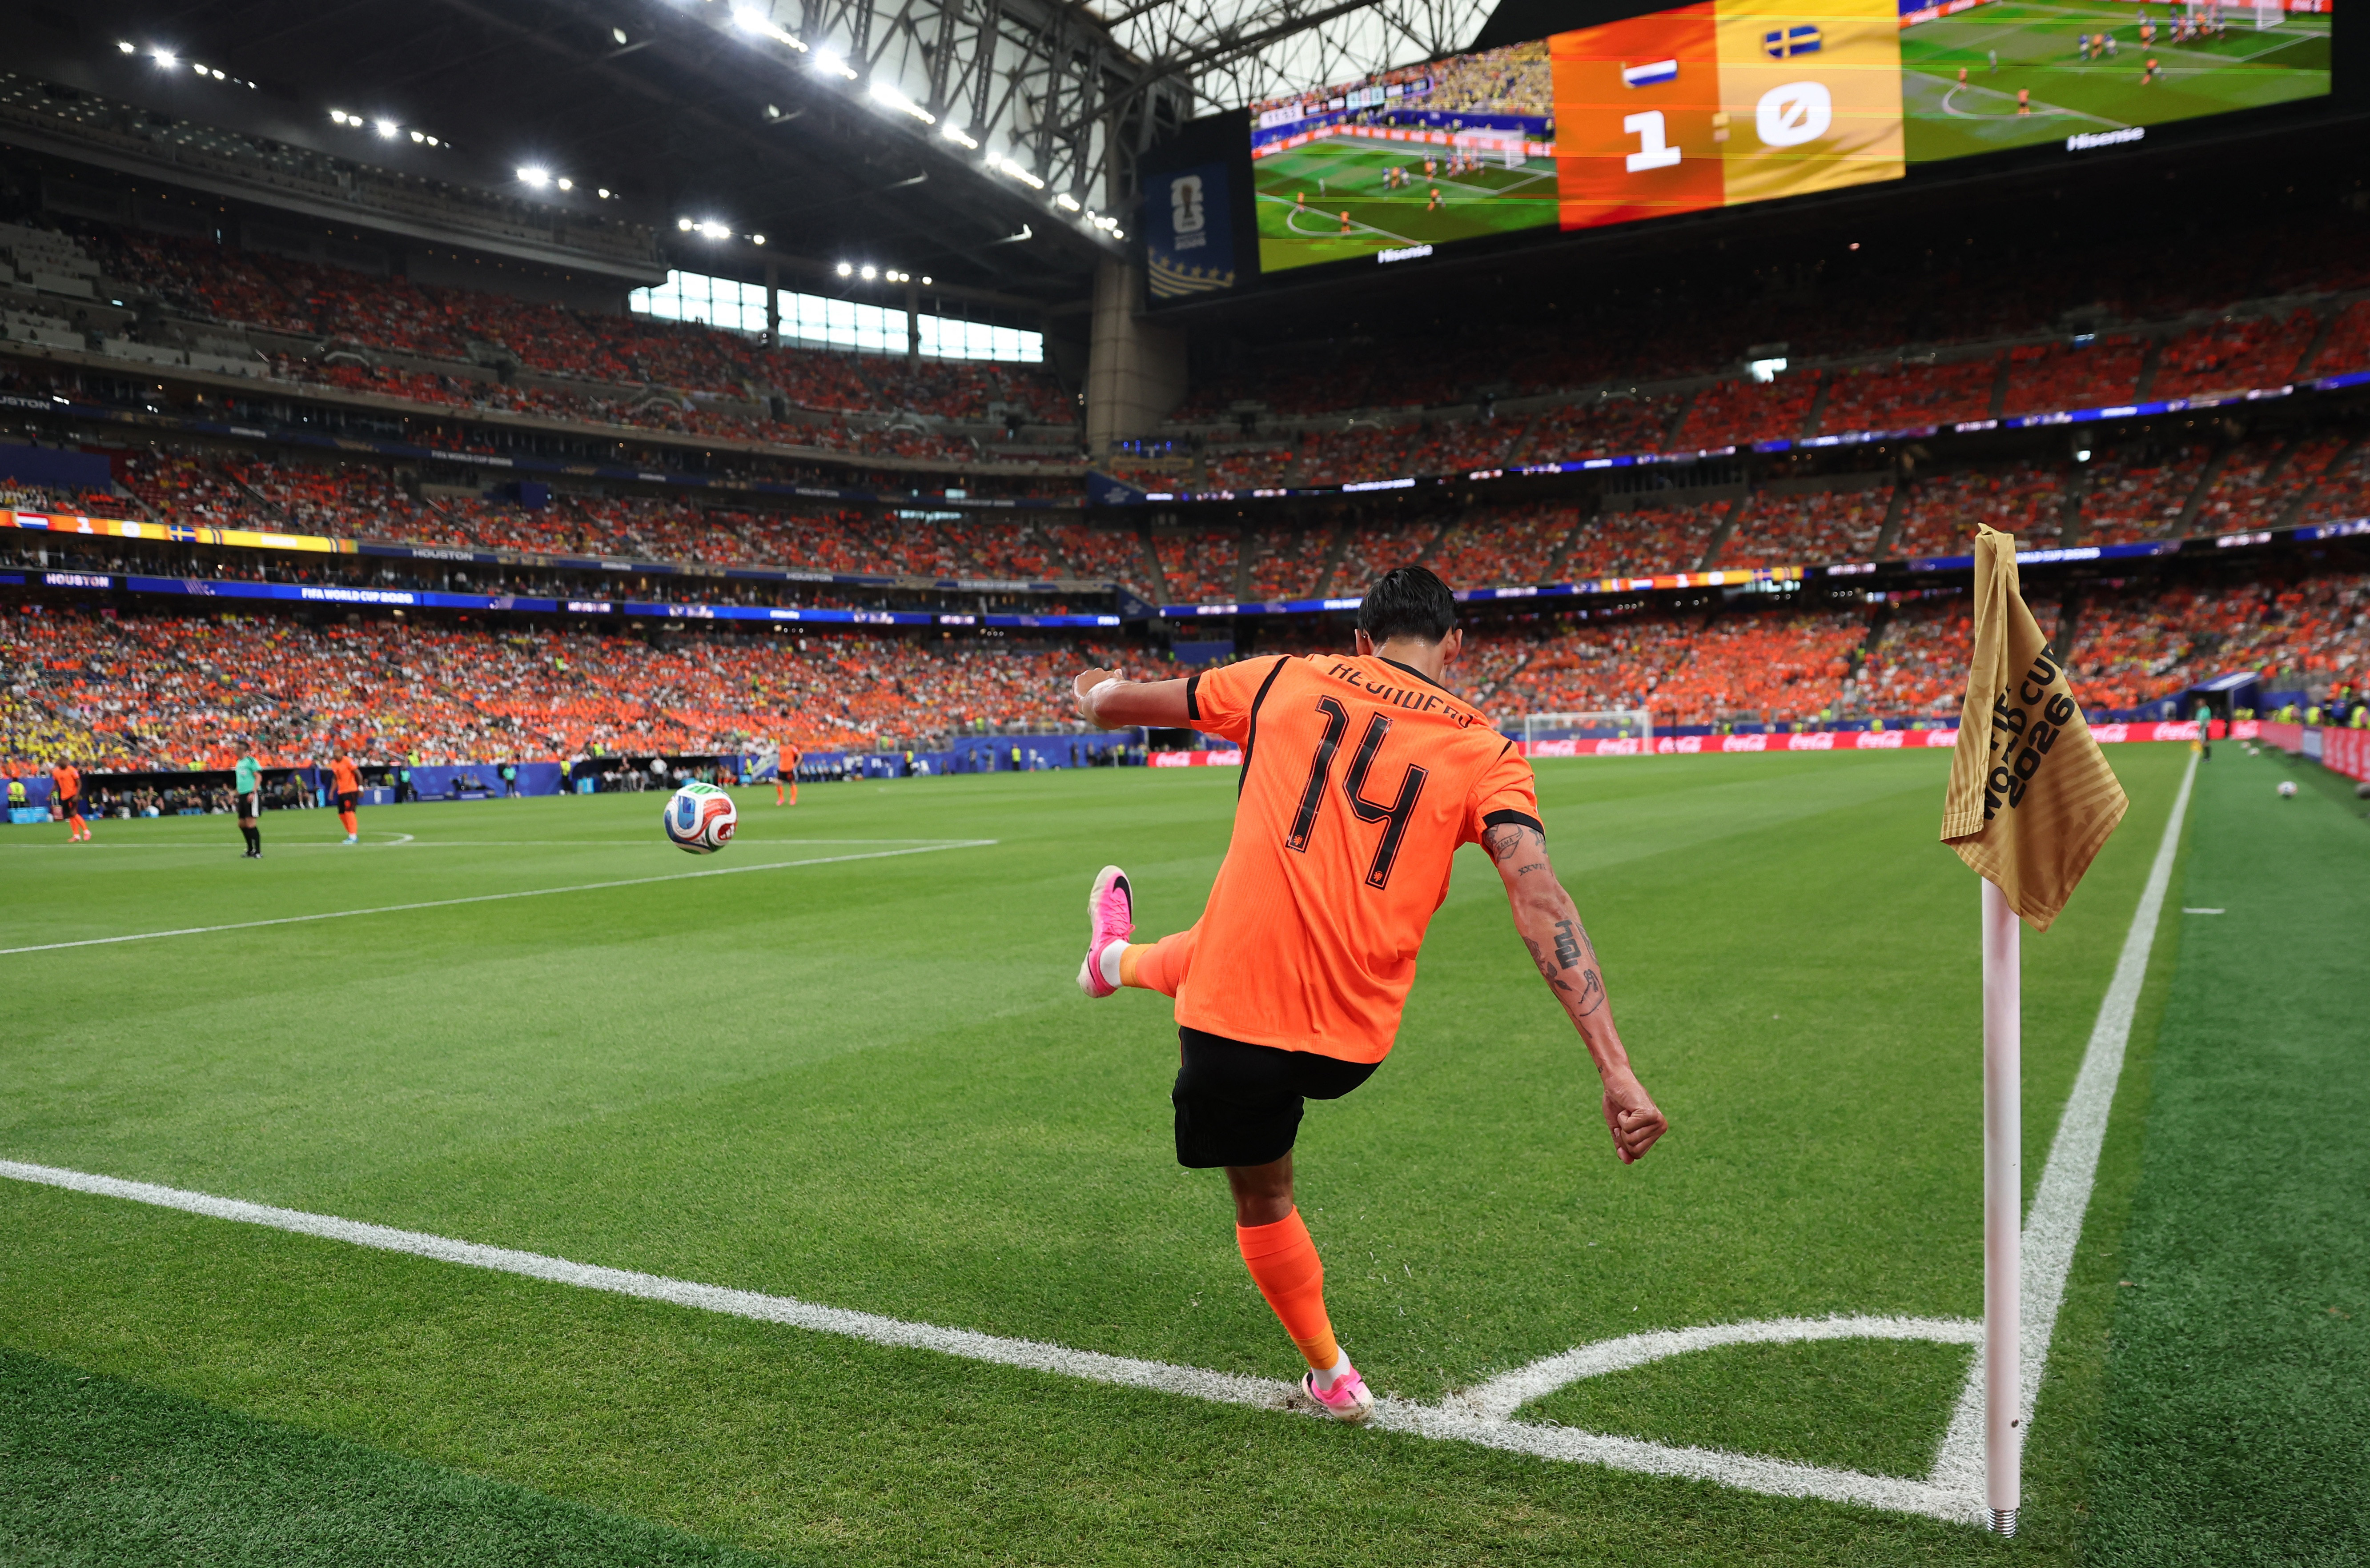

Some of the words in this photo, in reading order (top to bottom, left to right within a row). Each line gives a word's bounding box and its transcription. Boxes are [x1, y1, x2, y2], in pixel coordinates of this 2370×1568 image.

[1624, 110, 1681, 172] 1
[1756, 81, 1832, 146] 0
[2067, 127, 2145, 152] Hisense
[1378, 245, 1433, 264] Hisense
[77, 517, 93, 534] 1
[412, 548, 474, 561] HOUSTON
[46, 573, 109, 587] HOUSTON
[301, 587, 325, 600] FIFA
[325, 589, 360, 601] WORLD
[360, 590, 380, 602] CUP
[380, 592, 414, 604] 2026
[1723, 734, 1768, 752] Coca-Cola
[1788, 731, 1836, 750] Coca-Cola
[1856, 730, 1905, 749] Coca-Cola
[2009, 693, 2076, 809] 2026
[1285, 695, 1429, 891] 14
[1497, 838, 1514, 850] MAMA
